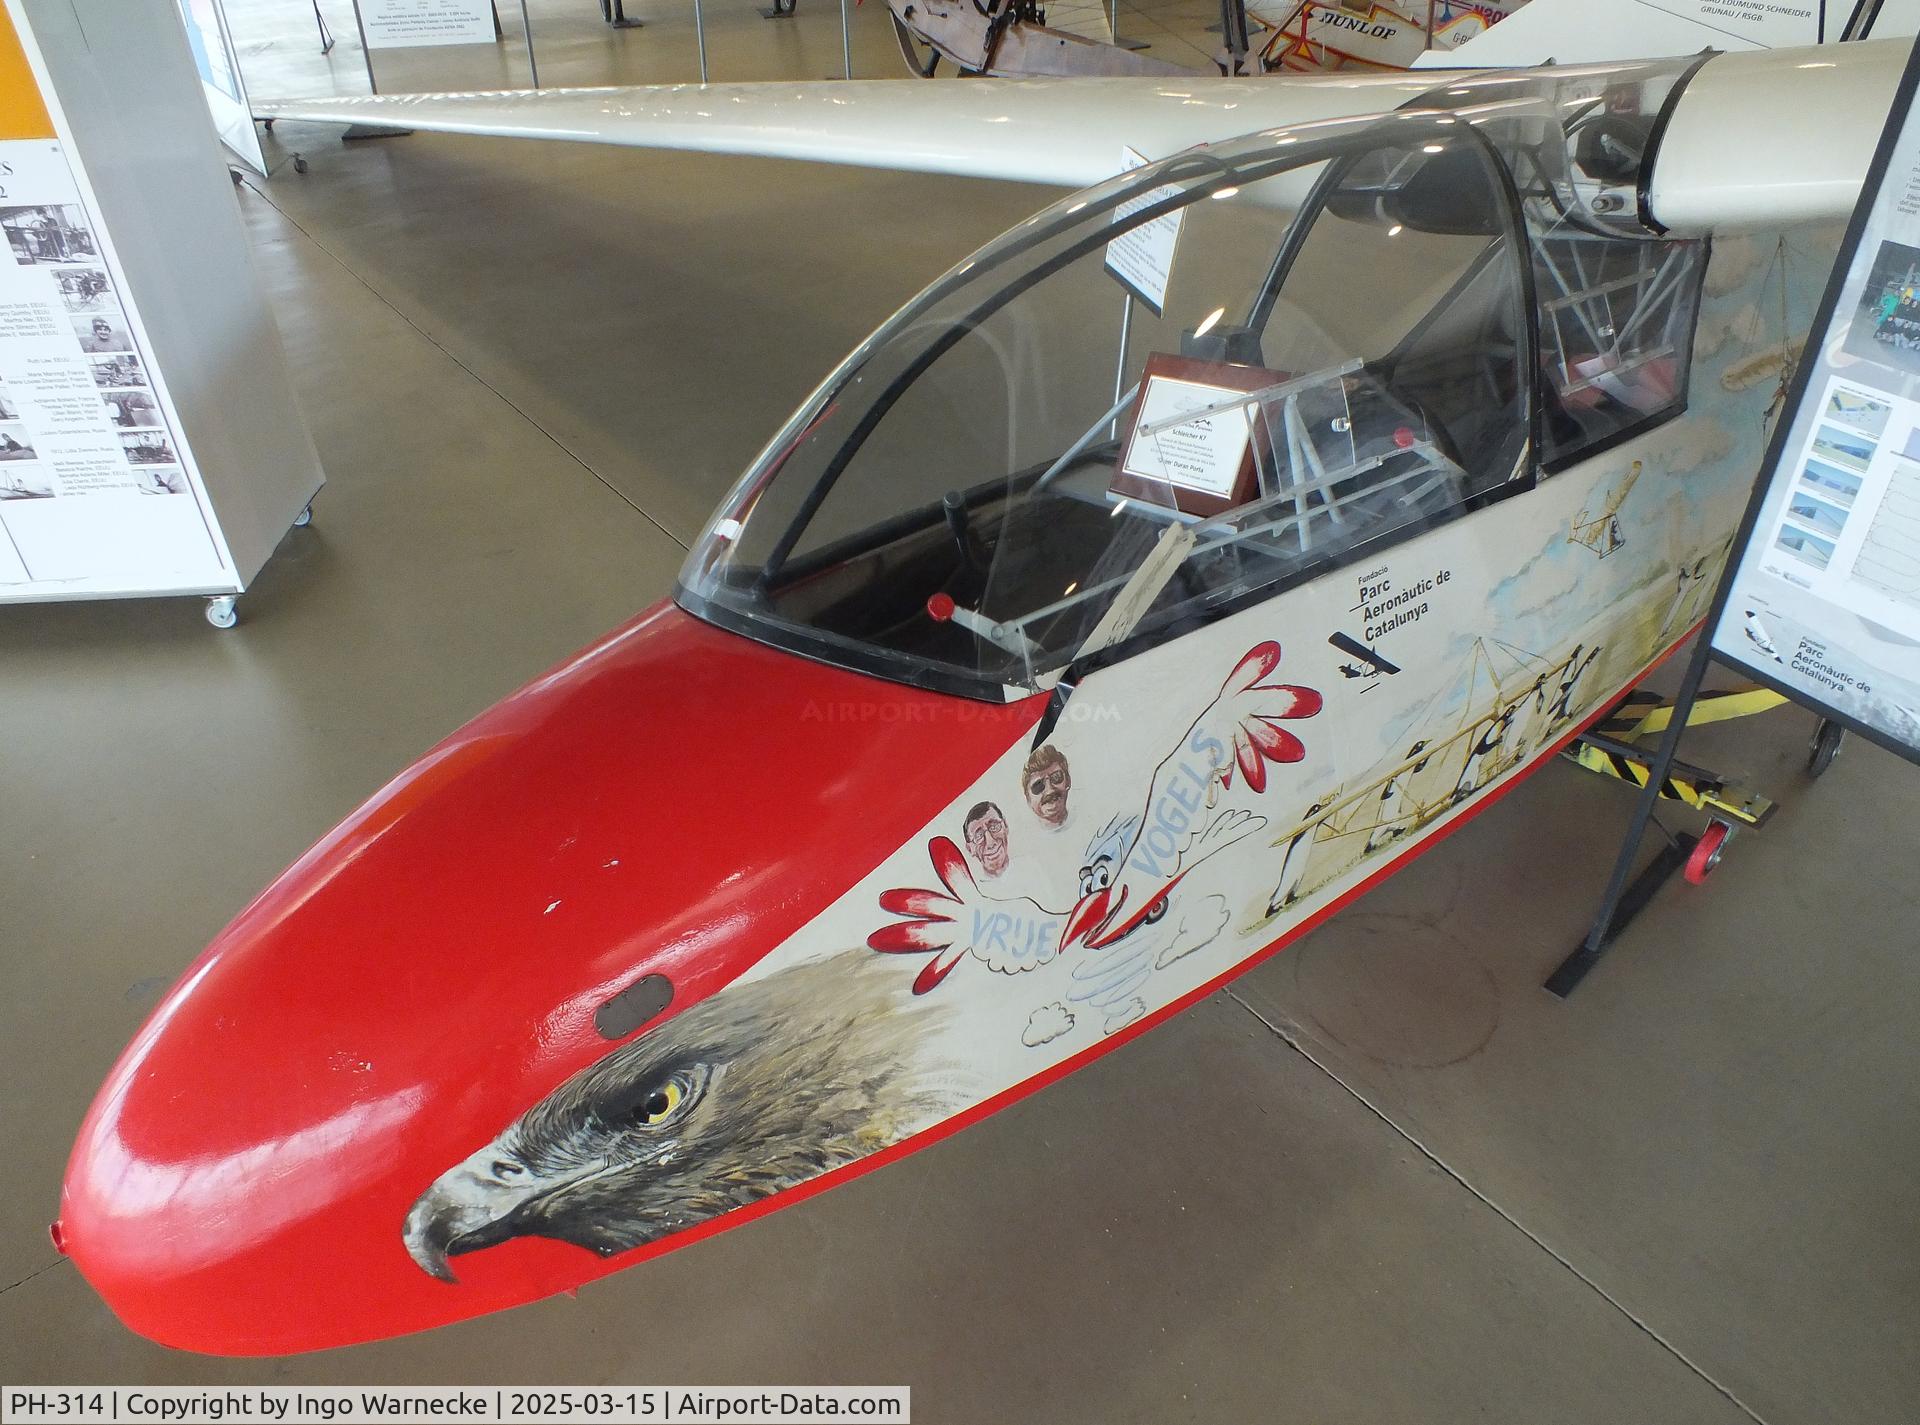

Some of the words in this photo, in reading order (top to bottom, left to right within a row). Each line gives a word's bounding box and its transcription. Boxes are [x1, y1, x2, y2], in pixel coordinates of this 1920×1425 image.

[1700, 6, 1735, 18] GRUNAU
[1765, 4, 1812, 19] SCHNEIDER
[1318, 12, 1397, 40] DUNLOP
[1357, 565, 1389, 585] Fundació
[1359, 579, 1392, 603] Parc
[1363, 579, 1433, 623] Aeronàutic
[1436, 570, 1451, 586] de
[1365, 602, 1429, 642] Catalunya
[1798, 641, 1824, 659] Parc
[1791, 659, 1846, 692] Catalunya
[1794, 651, 1855, 685] Aeronàutic
[1856, 681, 1872, 694] de
[1130, 727, 1226, 879] VOGELS
